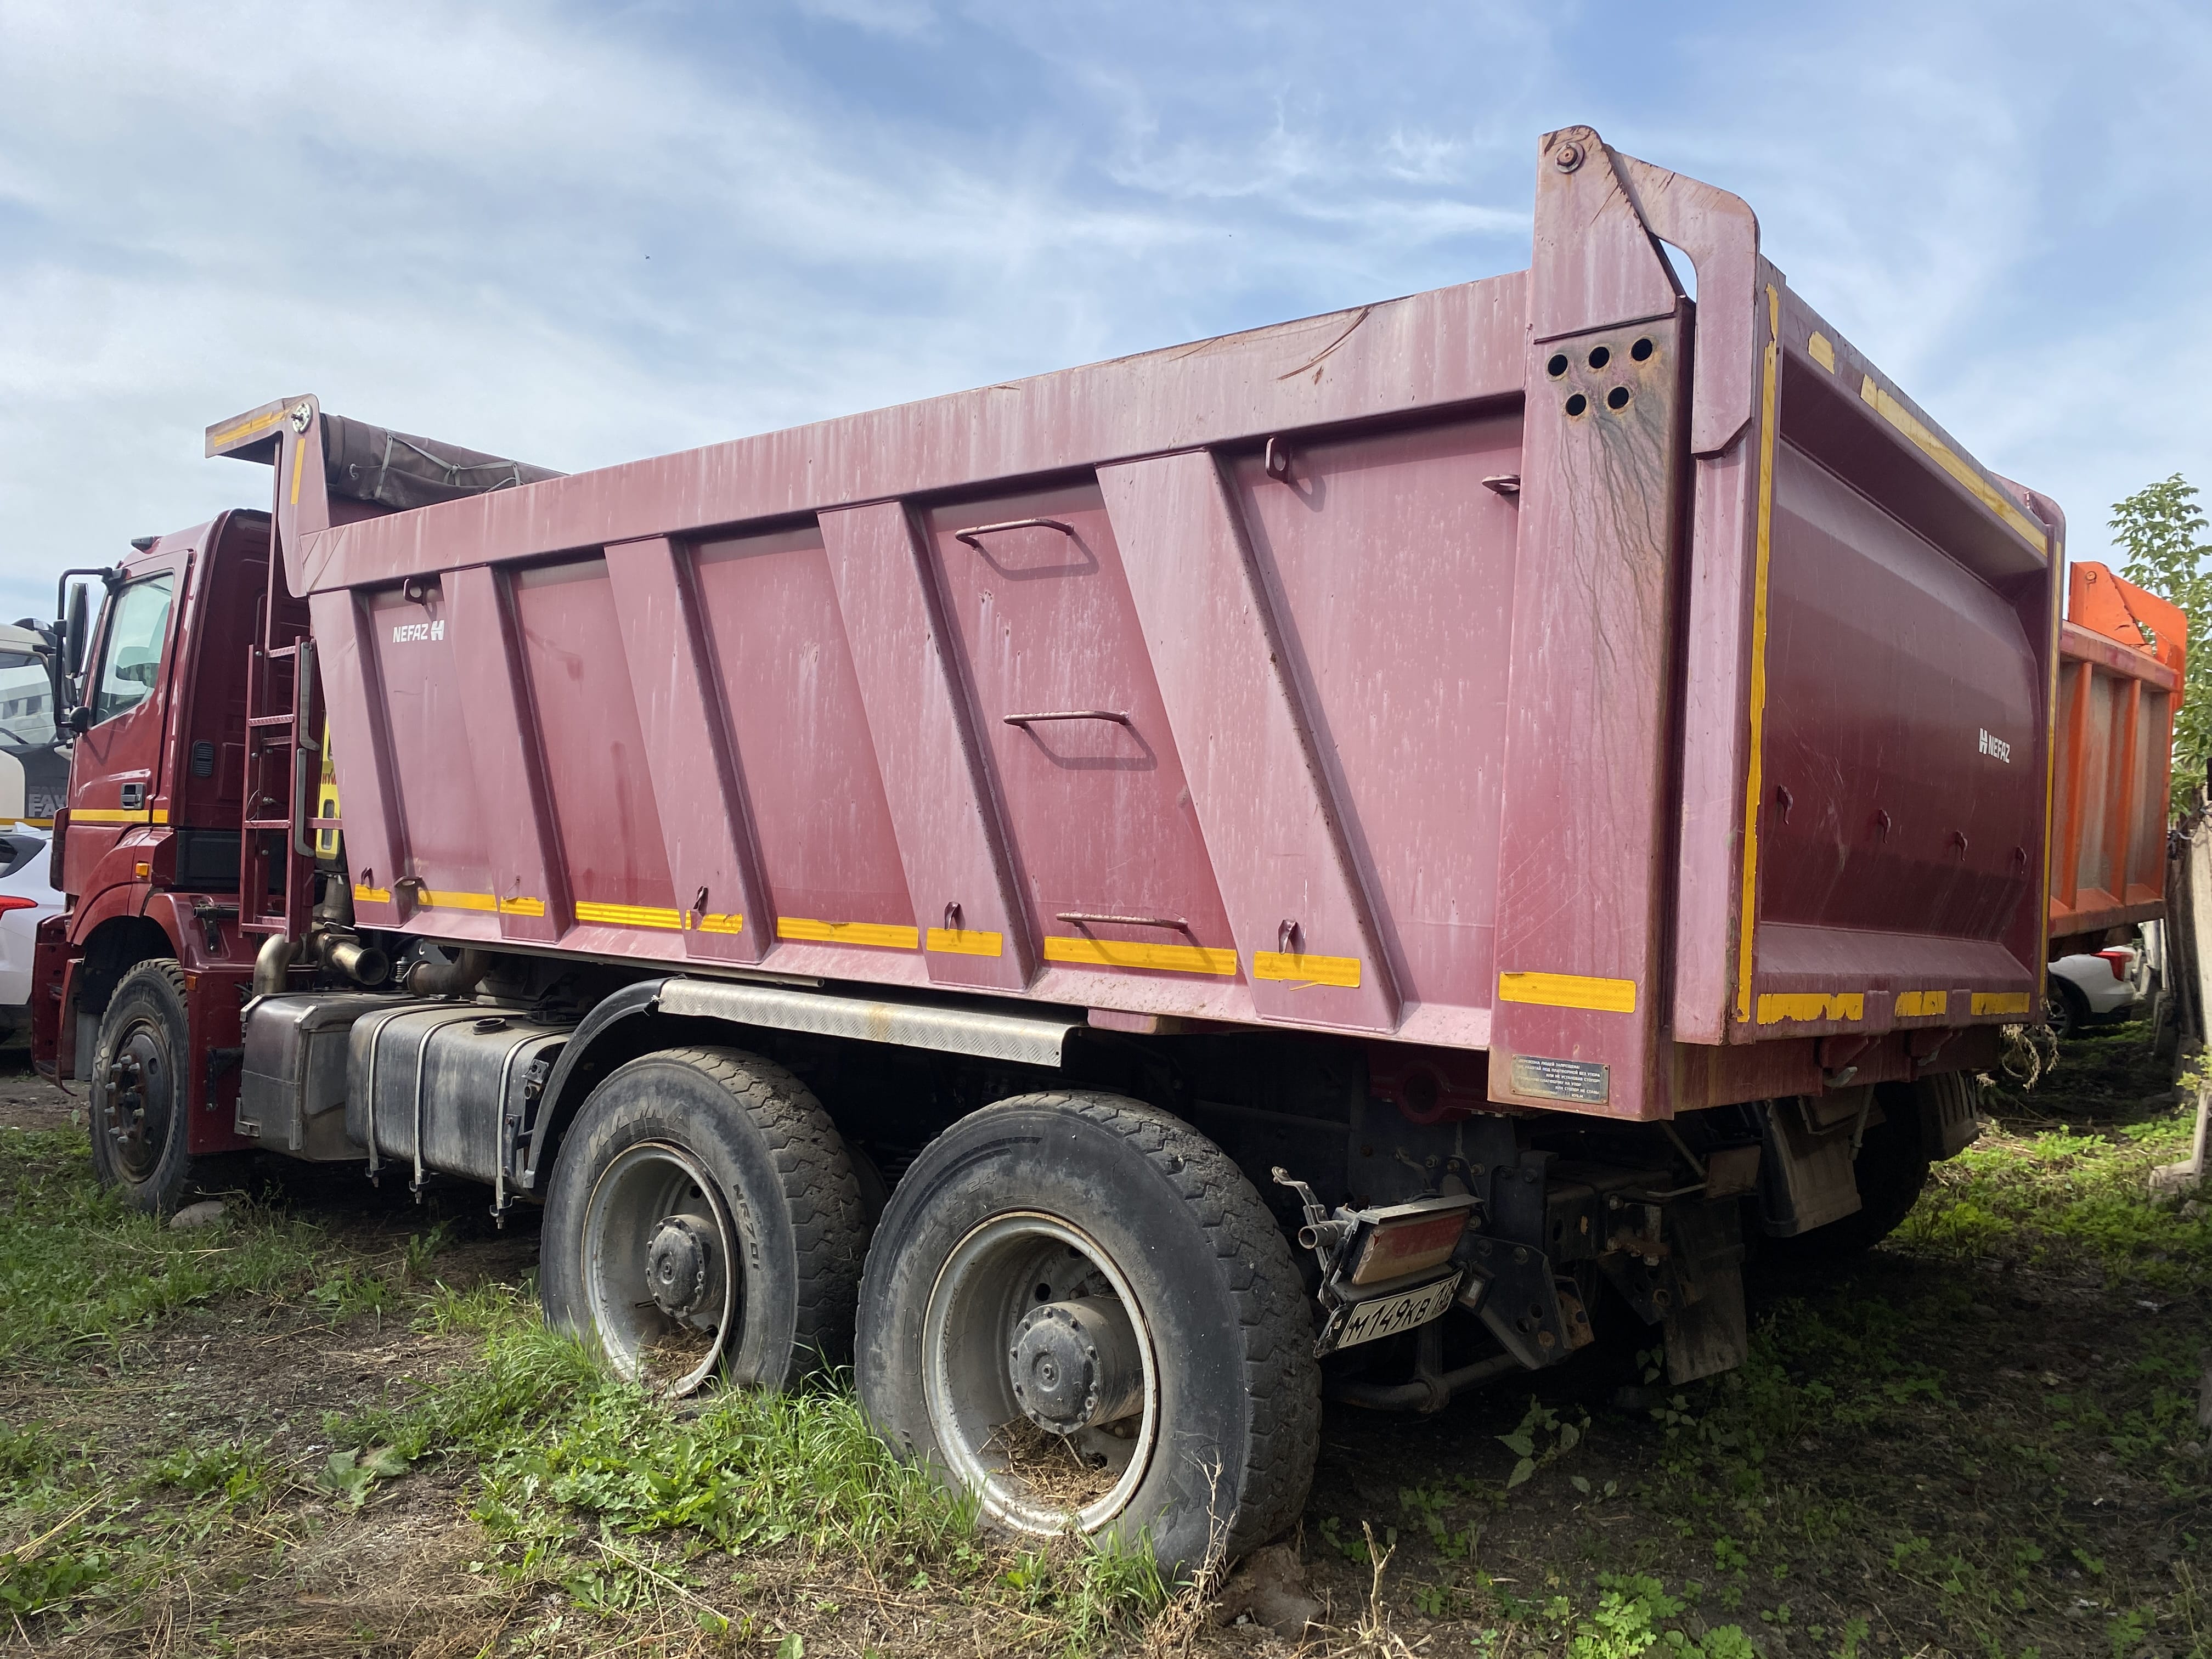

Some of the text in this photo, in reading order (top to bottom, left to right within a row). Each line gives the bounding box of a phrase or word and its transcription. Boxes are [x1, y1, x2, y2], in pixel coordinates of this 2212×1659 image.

[393, 623, 429, 643] NEFAZ
[1988, 735, 2011, 764] NEFAZ
[321, 768, 337, 785] HYV
